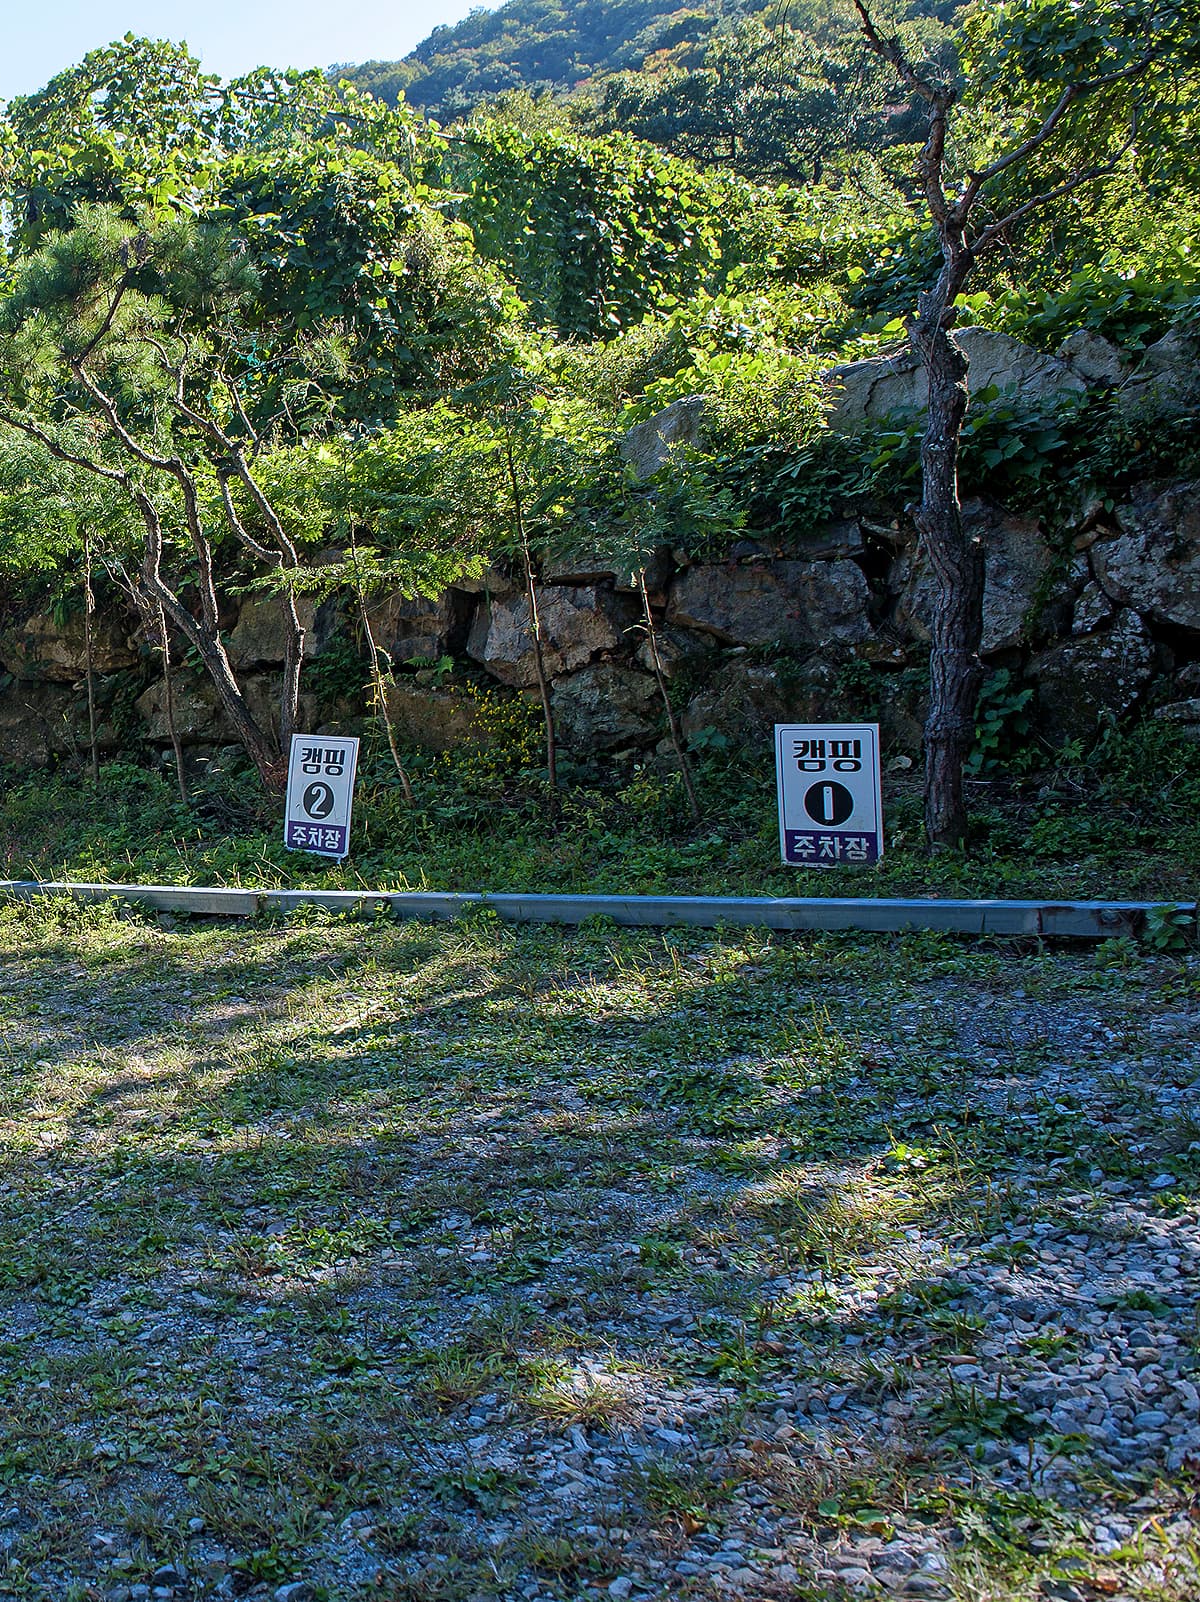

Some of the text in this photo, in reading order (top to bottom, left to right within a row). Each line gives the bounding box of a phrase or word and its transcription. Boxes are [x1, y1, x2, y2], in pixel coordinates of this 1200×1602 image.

[300, 747, 346, 776] 캠핑
[792, 739, 862, 772] 캠핑
[310, 786, 327, 815] 2
[292, 826, 341, 849] 주차장
[793, 835, 870, 860] 주차장
